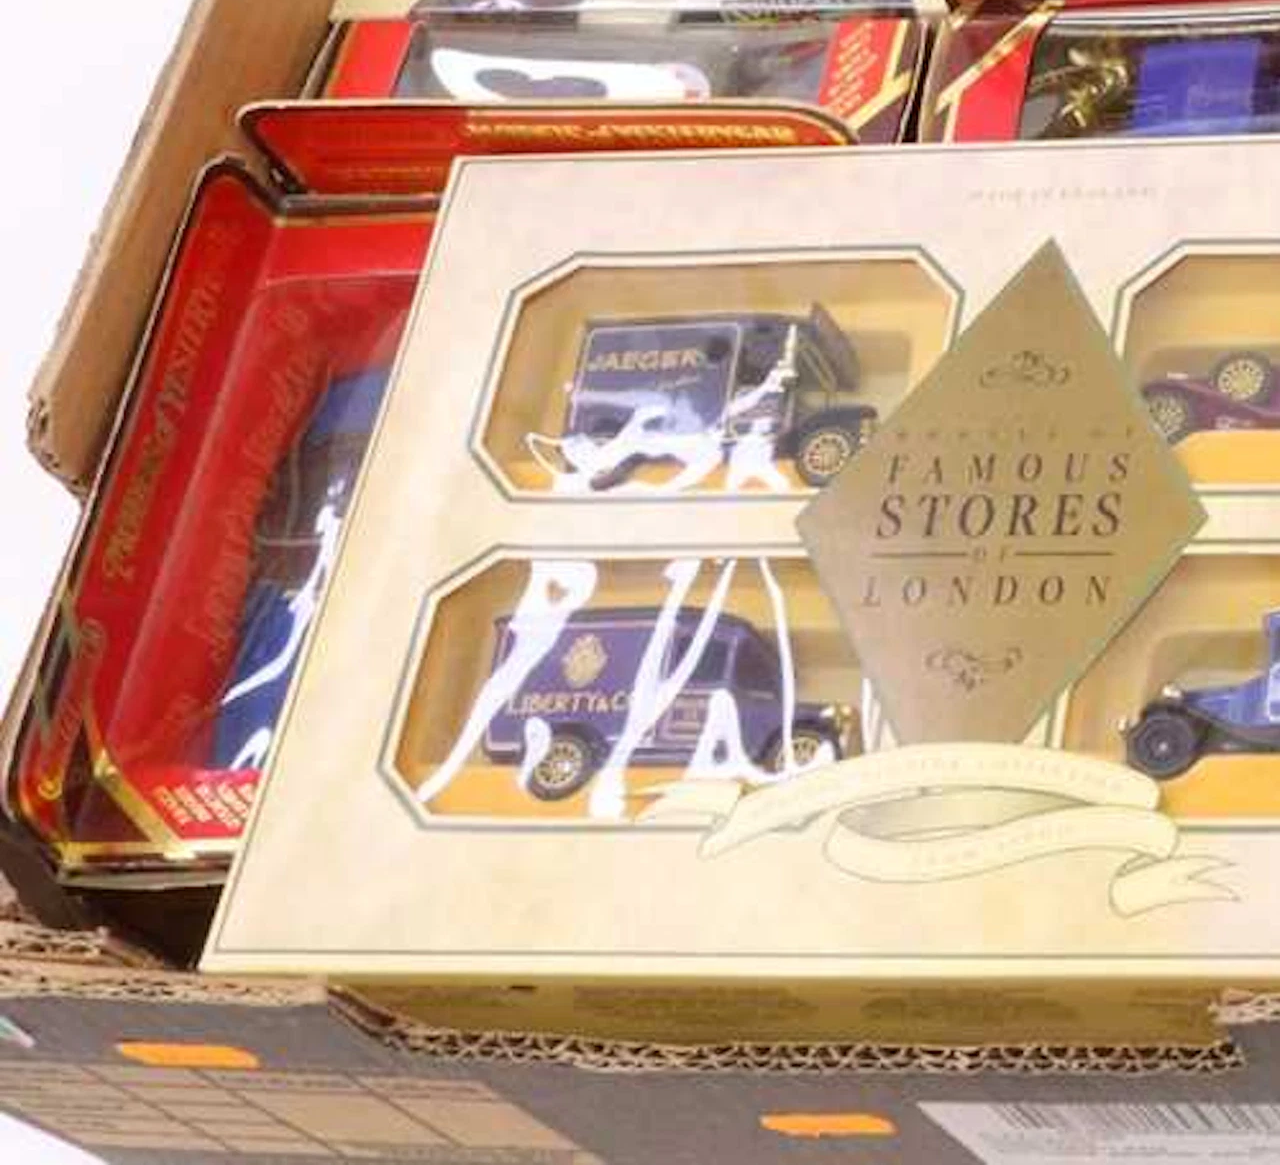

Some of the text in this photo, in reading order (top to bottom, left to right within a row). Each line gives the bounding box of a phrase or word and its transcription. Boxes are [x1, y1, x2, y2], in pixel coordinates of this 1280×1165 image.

[586, 349, 706, 372] JAEGER
[887, 452, 1132, 485] FAMOUS
[876, 491, 1123, 537] STORES
[860, 575, 1112, 607] LONDON
